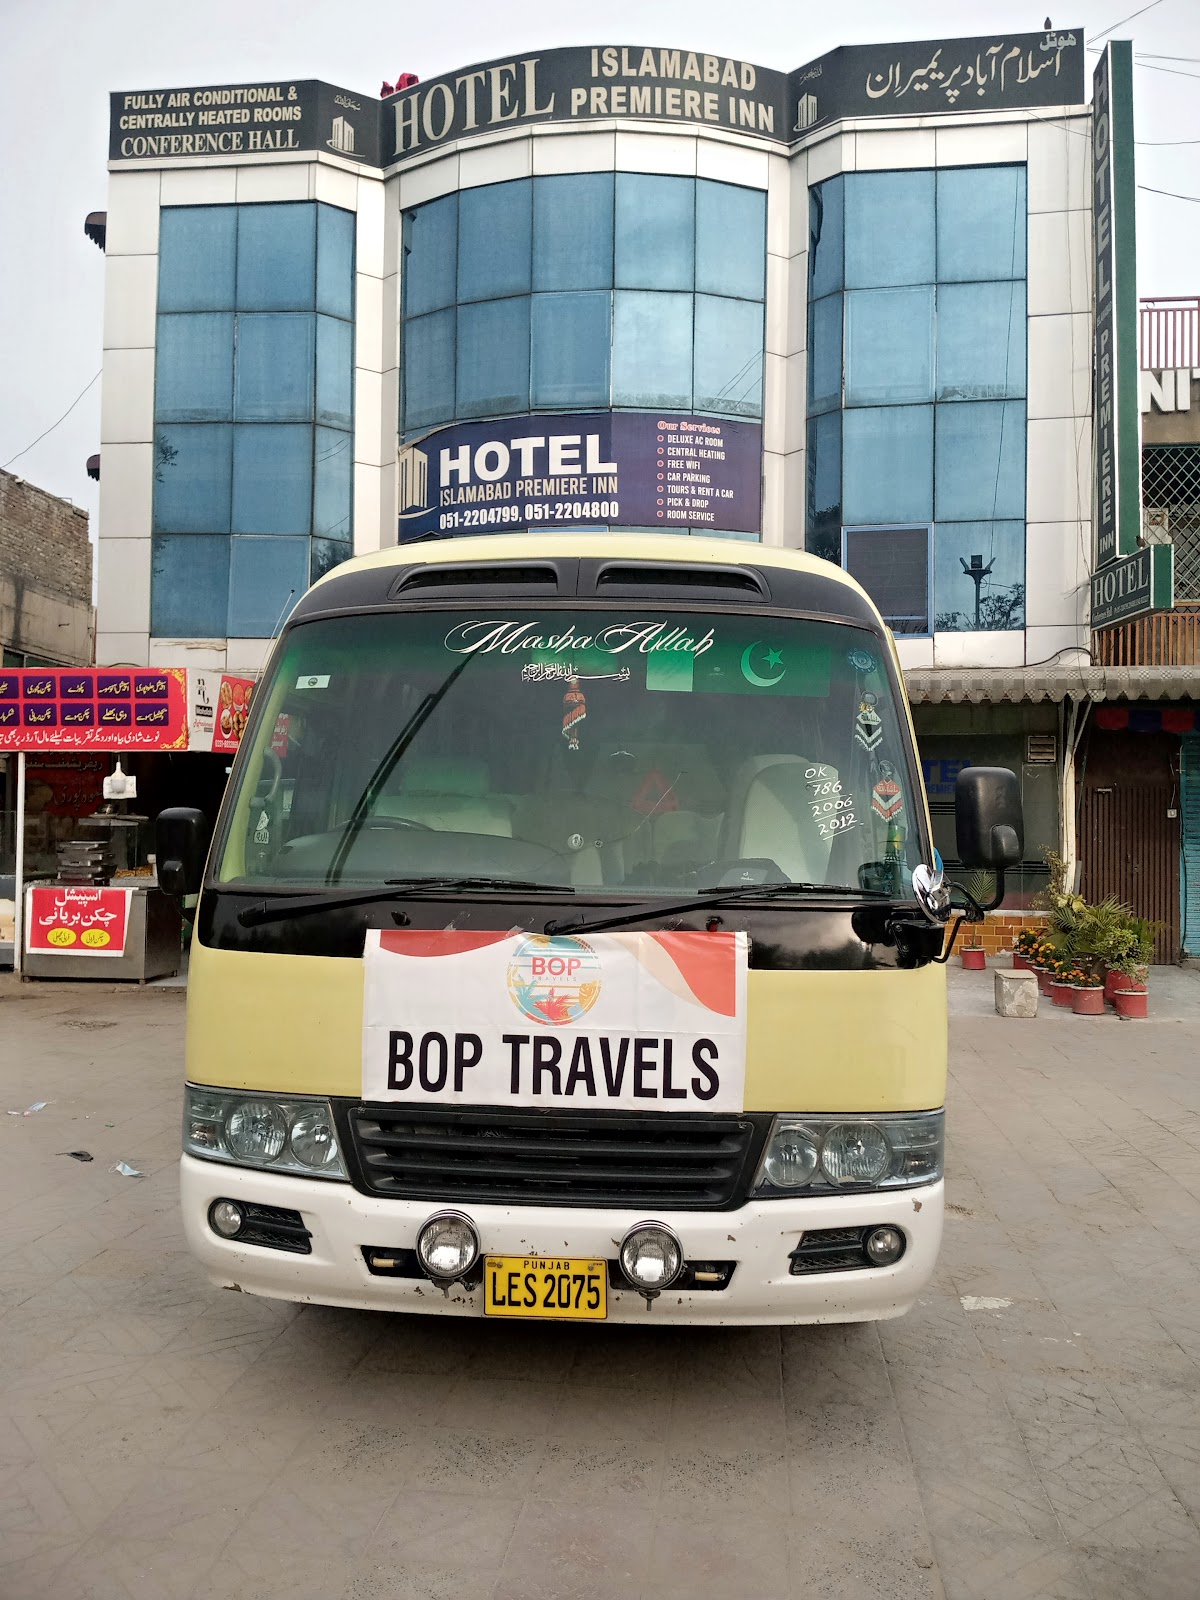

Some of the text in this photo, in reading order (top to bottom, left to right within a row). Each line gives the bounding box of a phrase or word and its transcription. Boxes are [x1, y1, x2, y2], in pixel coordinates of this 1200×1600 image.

[591, 48, 757, 91] ISLAMABAD
[124, 86, 298, 110] FULLY AIR CONDITIONAL &
[392, 59, 555, 156] HOTEL
[571, 86, 720, 120] PREMIERE
[729, 98, 774, 133] INN
[119, 106, 302, 130] CENTRALLY HEATED ROOMS
[120, 129, 300, 157] CONFERENCE HALL
[1095, 60, 1110, 303] HOTEL
[657, 420, 721, 434] Our Services
[1099, 329, 1112, 525] PREMIERE
[667, 434, 724, 447] DELUXE AC ROOM
[440, 434, 618, 487] HOTEL
[667, 447, 725, 460] CENTRAL HEATING
[667, 460, 701, 470] FREE WIFI
[667, 472, 711, 484] CAR PARKING
[440, 476, 618, 507] ISLAMABAD PREMIERE INN
[667, 485, 734, 499] TOURS & RENT A CAR
[667, 498, 709, 508] PICK & DROP
[439, 501, 619, 530] 051-2204799, 051-2204800
[667, 510, 715, 522] ROOM SERVICE
[1100, 532, 1115, 555] INN
[1093, 557, 1149, 608] HOTEL
[444, 620, 716, 659] Masha Allah
[63, 728, 95, 746] تقریبات
[124, 731, 143, 744] شادی
[142, 731, 160, 743] نوٹ
[804, 766, 828, 779] OK
[812, 780, 843, 796] 786
[811, 797, 853, 818] 2006
[818, 813, 858, 836] 2012
[55, 889, 102, 907] اسپیشل
[39, 907, 117, 927] چکن بریانی
[532, 956, 582, 976] BOP
[387, 1030, 720, 1101] BOP TRAVELS
[523, 1260, 570, 1270] PUNJAB
[492, 1272, 601, 1309] LES 2075
